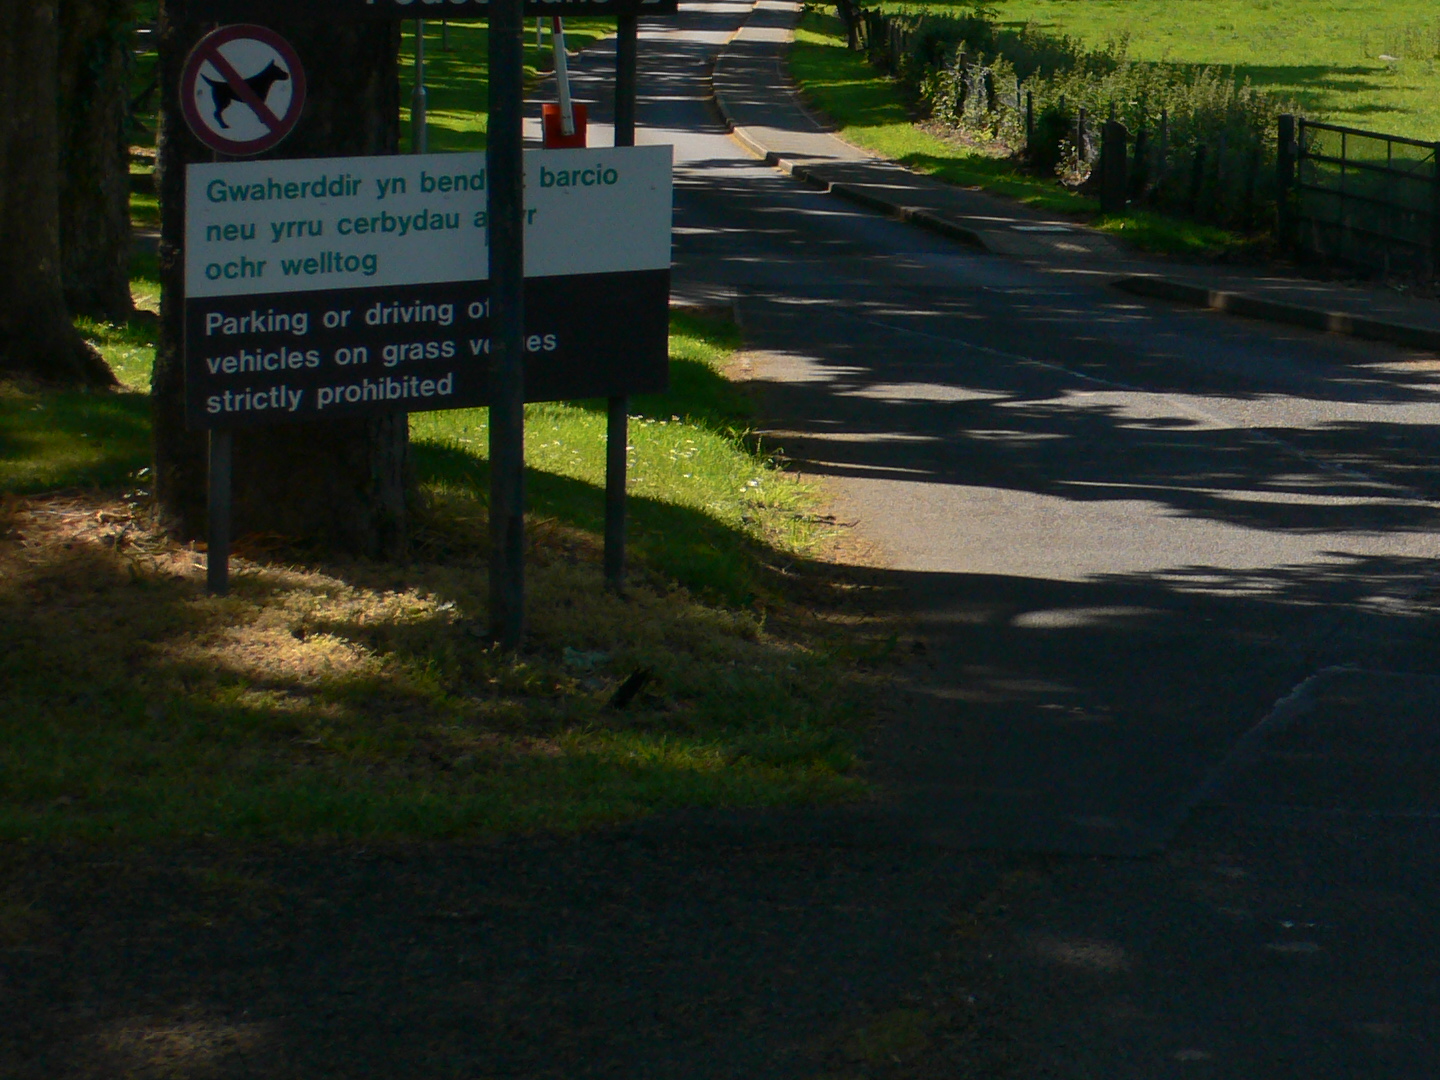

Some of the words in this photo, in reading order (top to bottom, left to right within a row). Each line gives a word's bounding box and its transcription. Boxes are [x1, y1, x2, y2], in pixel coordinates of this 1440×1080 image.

[206, 173, 361, 202] Gwaherddir
[376, 177, 406, 199] yn
[540, 164, 618, 188] barcio
[206, 223, 255, 241] neu
[271, 220, 322, 243] yrru
[337, 209, 459, 236] cerbydau
[206, 257, 267, 280] ochr
[281, 251, 377, 275] welltog
[206, 309, 309, 336] Parking
[323, 309, 351, 328] or
[365, 300, 454, 325] driving
[207, 346, 320, 374] vehicles
[334, 346, 368, 365] on
[382, 339, 456, 367] grass
[206, 384, 304, 413] strictly
[317, 372, 453, 409] prohibited
